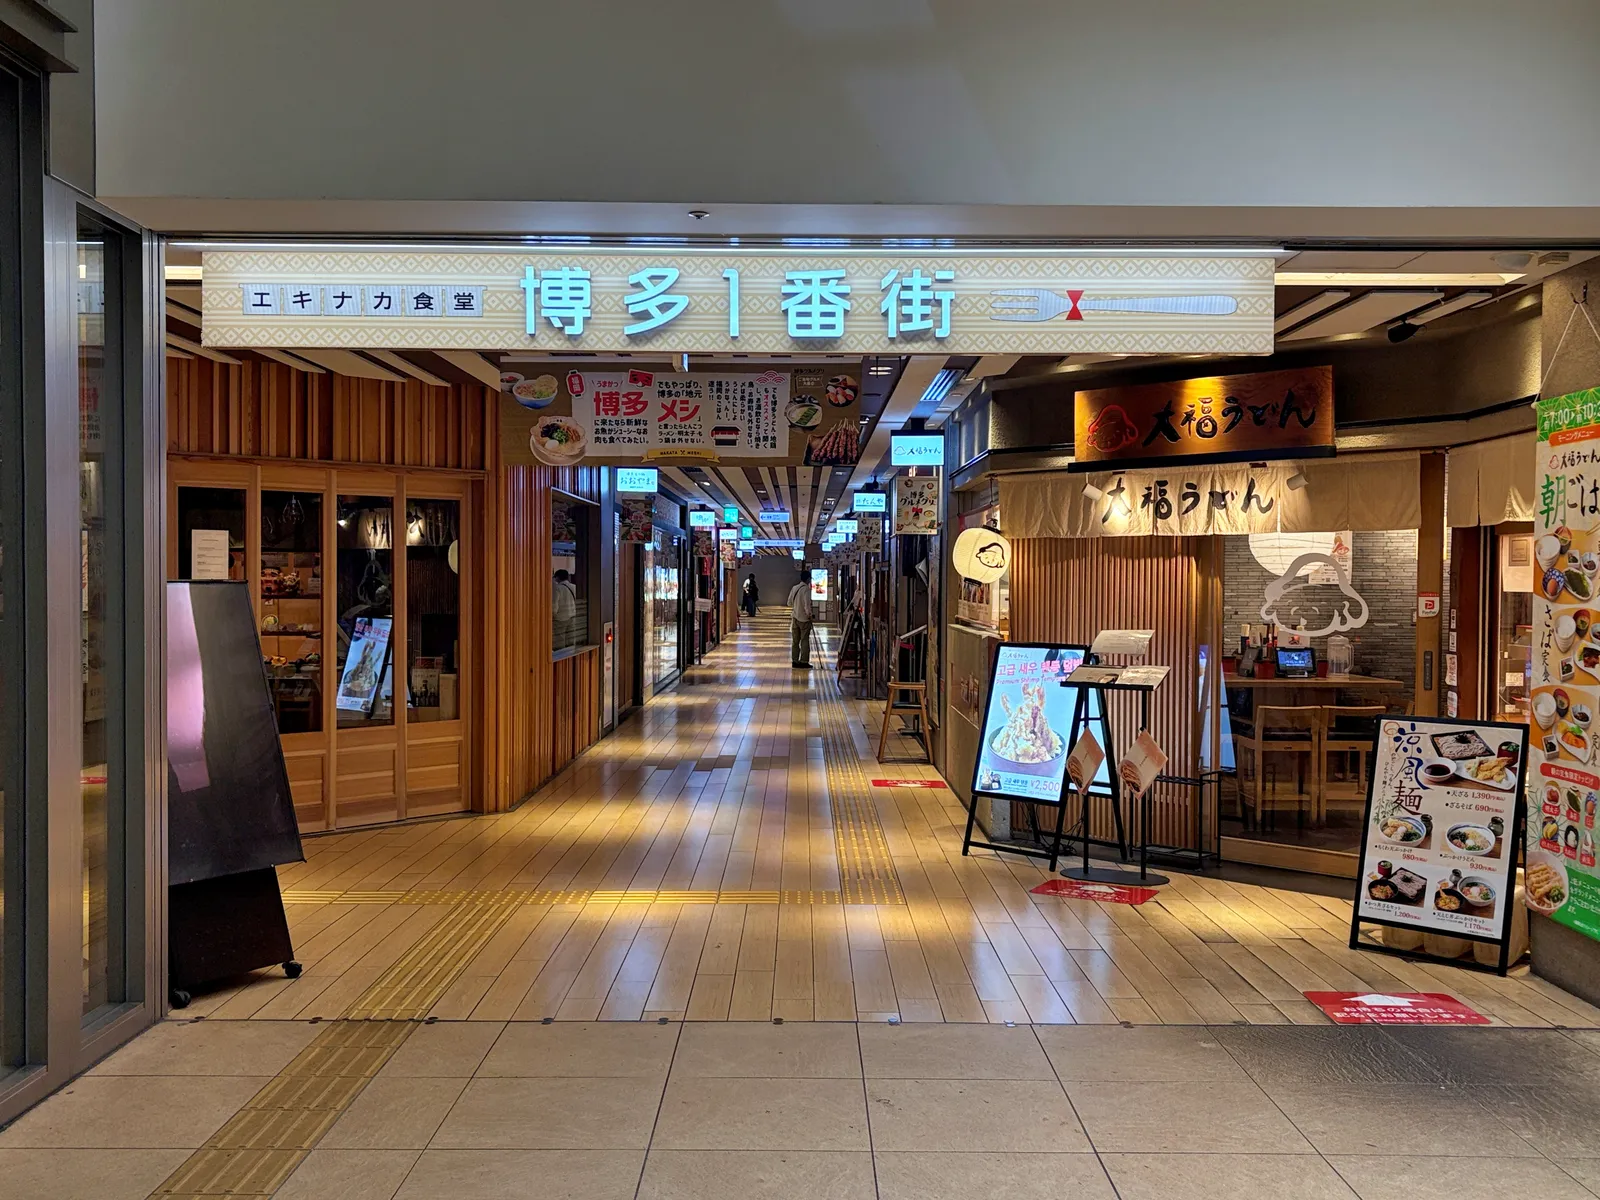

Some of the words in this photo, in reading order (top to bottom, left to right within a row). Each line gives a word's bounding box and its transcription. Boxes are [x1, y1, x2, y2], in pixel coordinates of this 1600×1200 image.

[251, 289, 476, 312] エキナカ食堂
[519, 265, 955, 340] 博多1番街
[657, 380, 703, 389] でもやっぱり、
[657, 389, 703, 398] 博多の「地元
[593, 391, 649, 416] 博多
[1142, 389, 1317, 440] 大福うどん
[593, 418, 648, 426] に来たなら新鮮な
[594, 436, 650, 444] 肉も食べてみたい。
[1101, 476, 1274, 523] 大福うどん
[997, 663, 1016, 676] 고급
[1018, 661, 1038, 675] 새우
[1030, 779, 1061, 792] ¥2,500
[1450, 790, 1469, 798] 天ざる
[1449, 801, 1474, 810] ざるそば
[1443, 853, 1475, 863] ぶっかけうどん
